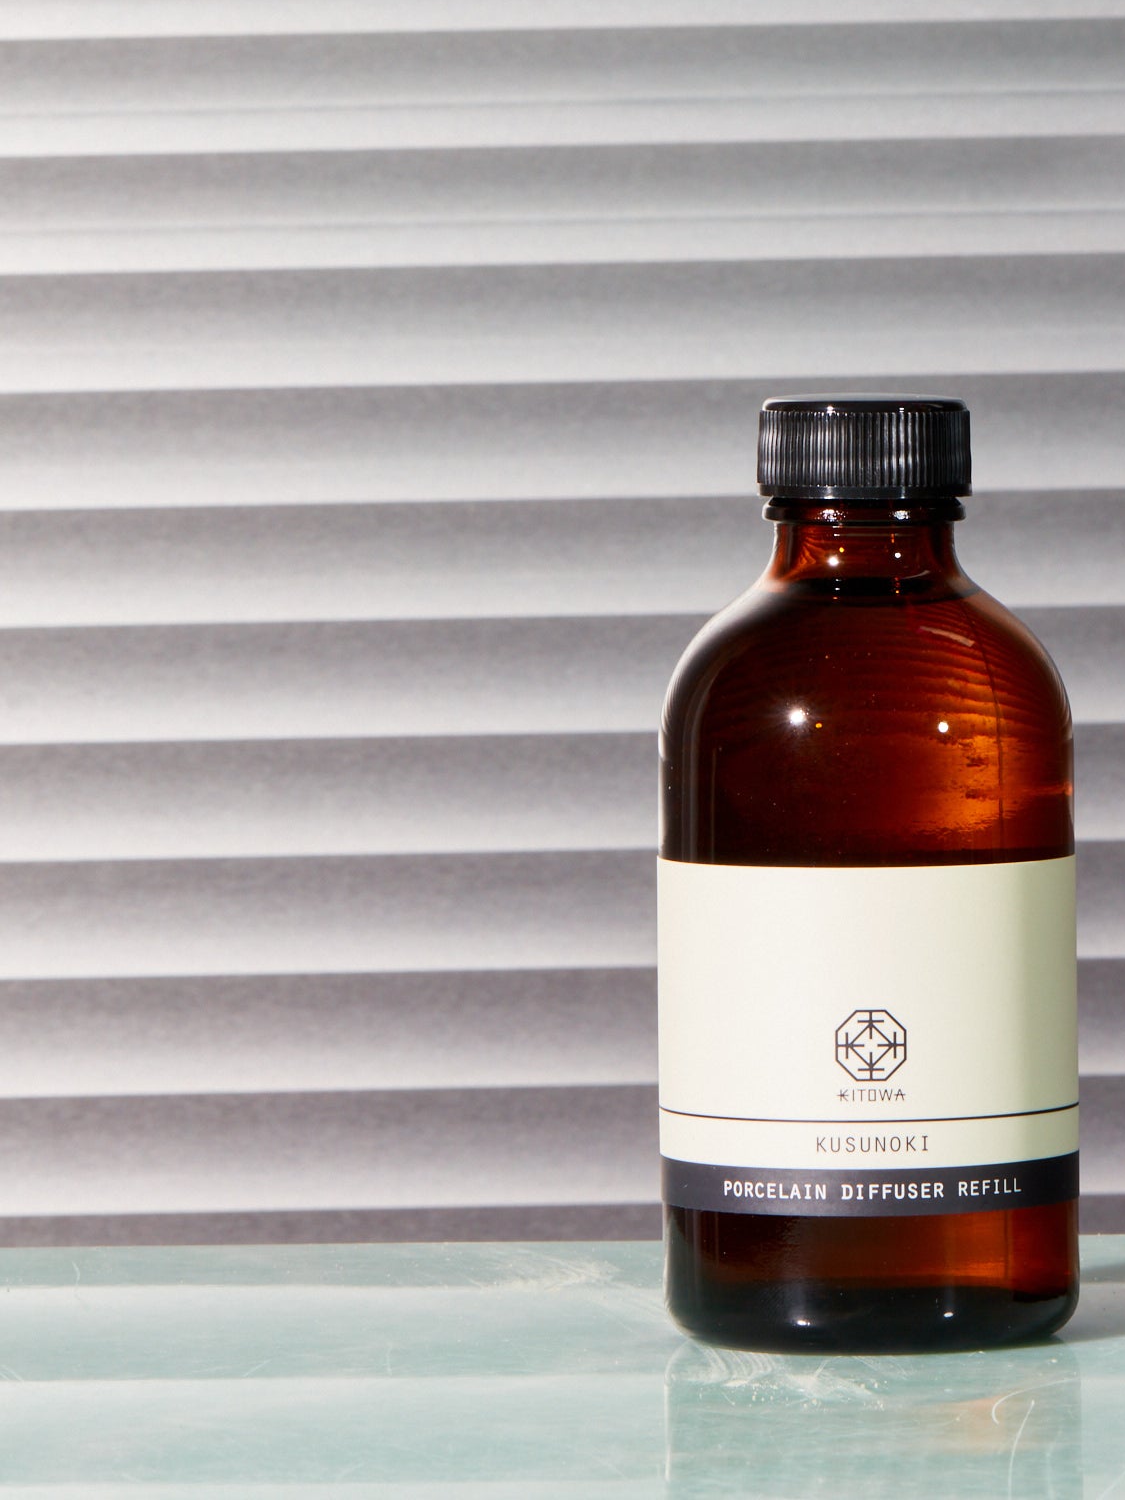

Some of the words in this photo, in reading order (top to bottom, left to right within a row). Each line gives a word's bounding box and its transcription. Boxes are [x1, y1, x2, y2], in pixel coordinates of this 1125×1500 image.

[815, 1135, 930, 1153] KUSUNOKI
[723, 1180, 827, 1200] PORCELAIN
[841, 1182, 945, 1201] DIFFUSER
[958, 1177, 1022, 1198] REFILL
